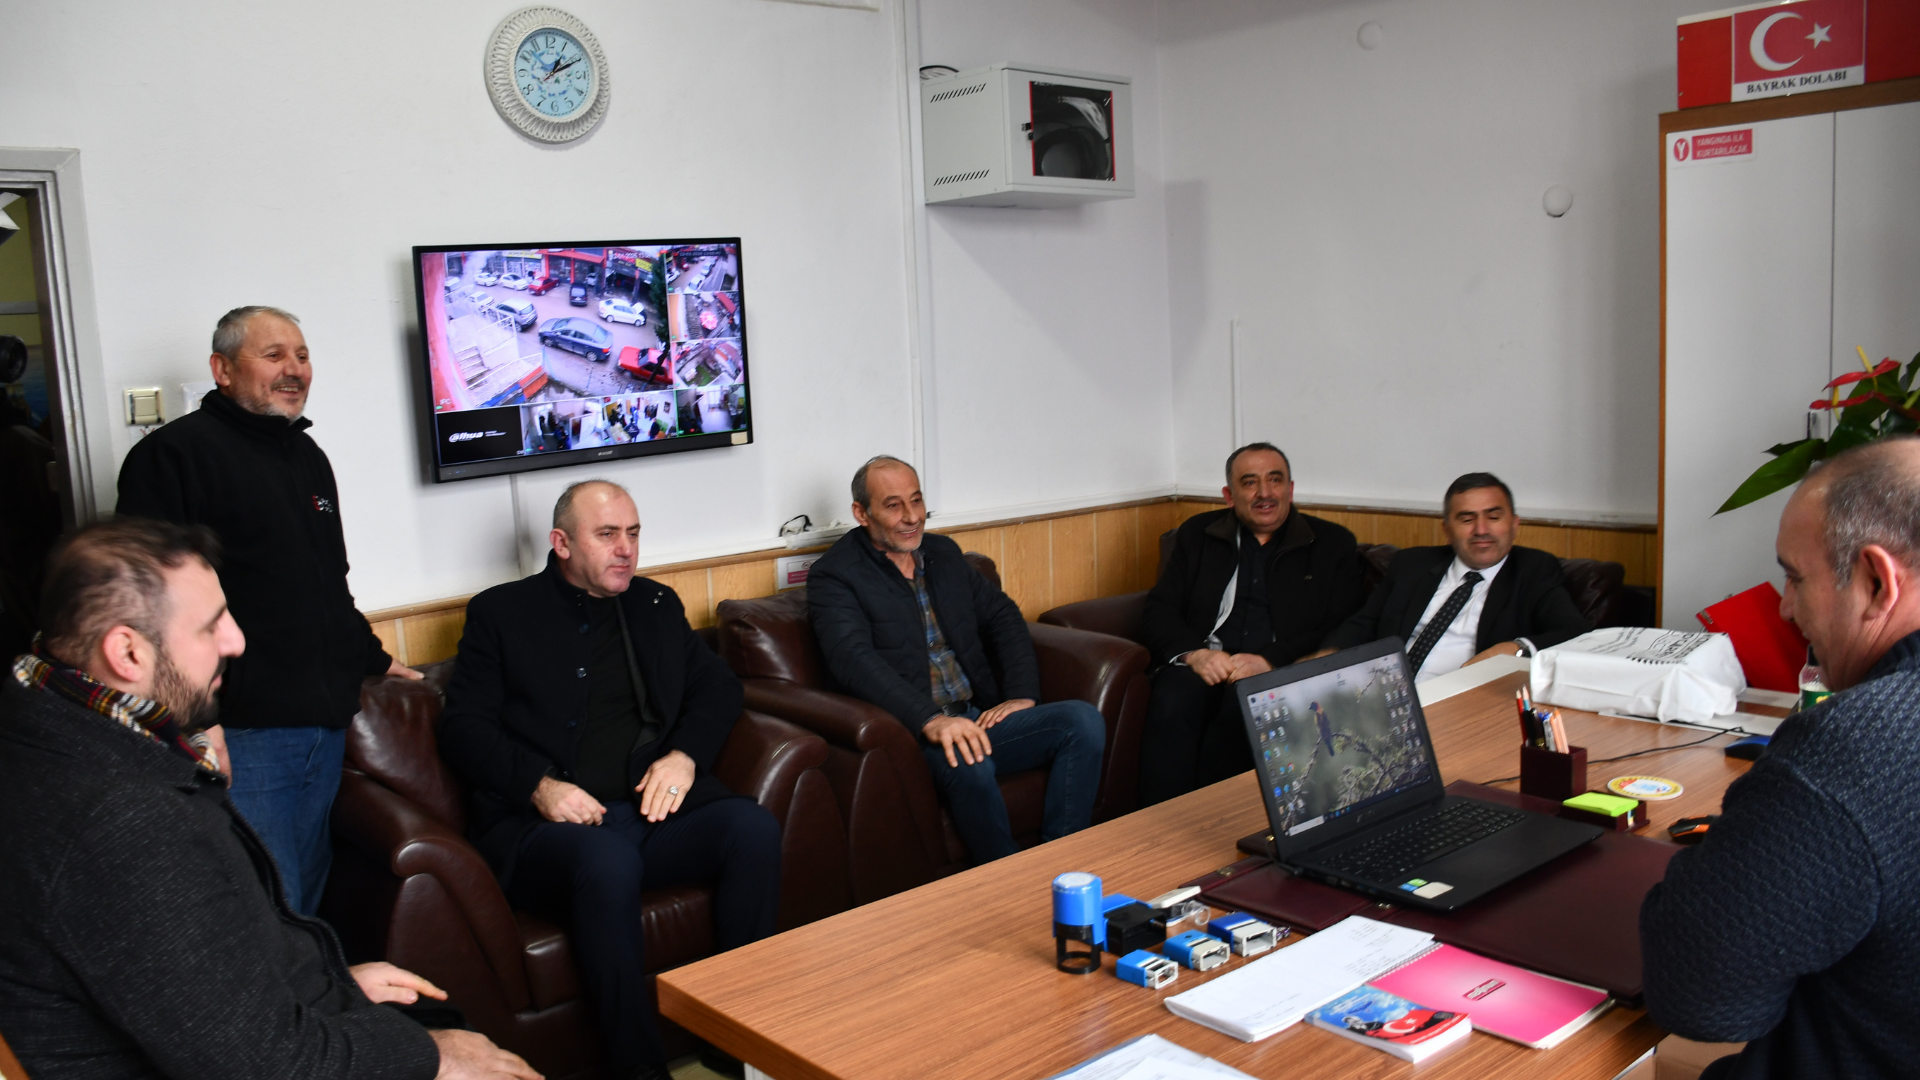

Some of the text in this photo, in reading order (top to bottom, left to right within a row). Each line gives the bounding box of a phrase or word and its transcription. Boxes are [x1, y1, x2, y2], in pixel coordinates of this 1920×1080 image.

[545, 36, 556, 49] 12
[561, 41, 568, 52] 1
[519, 49, 533, 64] 10
[518, 68, 529, 78] 9
[575, 70, 587, 80] 3
[1746, 70, 1847, 94] BAYRAK DOLABI
[523, 83, 534, 95] 8
[574, 86, 584, 96] 4
[536, 94, 547, 107] 7
[550, 100, 560, 113] 6
[563, 96, 574, 109] 5
[1697, 134, 1732, 147] YANGINDA
[1696, 144, 1748, 158] KURTARILACAK
